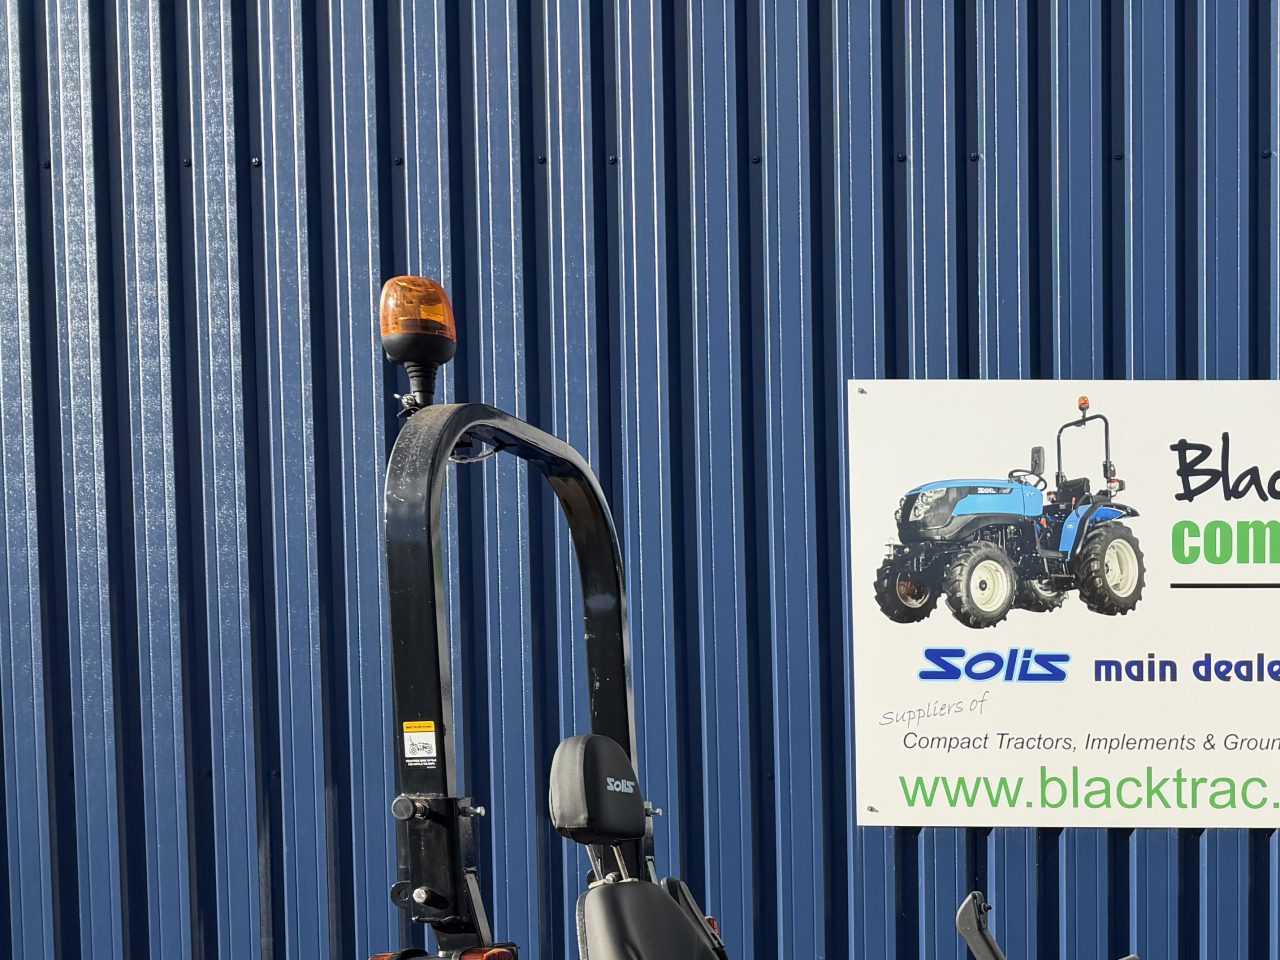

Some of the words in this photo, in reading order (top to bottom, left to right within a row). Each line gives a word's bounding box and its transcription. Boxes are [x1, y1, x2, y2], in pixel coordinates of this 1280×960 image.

[1094, 653, 1178, 681] main
[879, 700, 964, 728] Suppliers
[969, 691, 990, 715] of
[903, 732, 990, 753] Compact
[996, 732, 1077, 753] Tractors,
[1085, 733, 1196, 754] Implements
[1203, 733, 1216, 751] &
